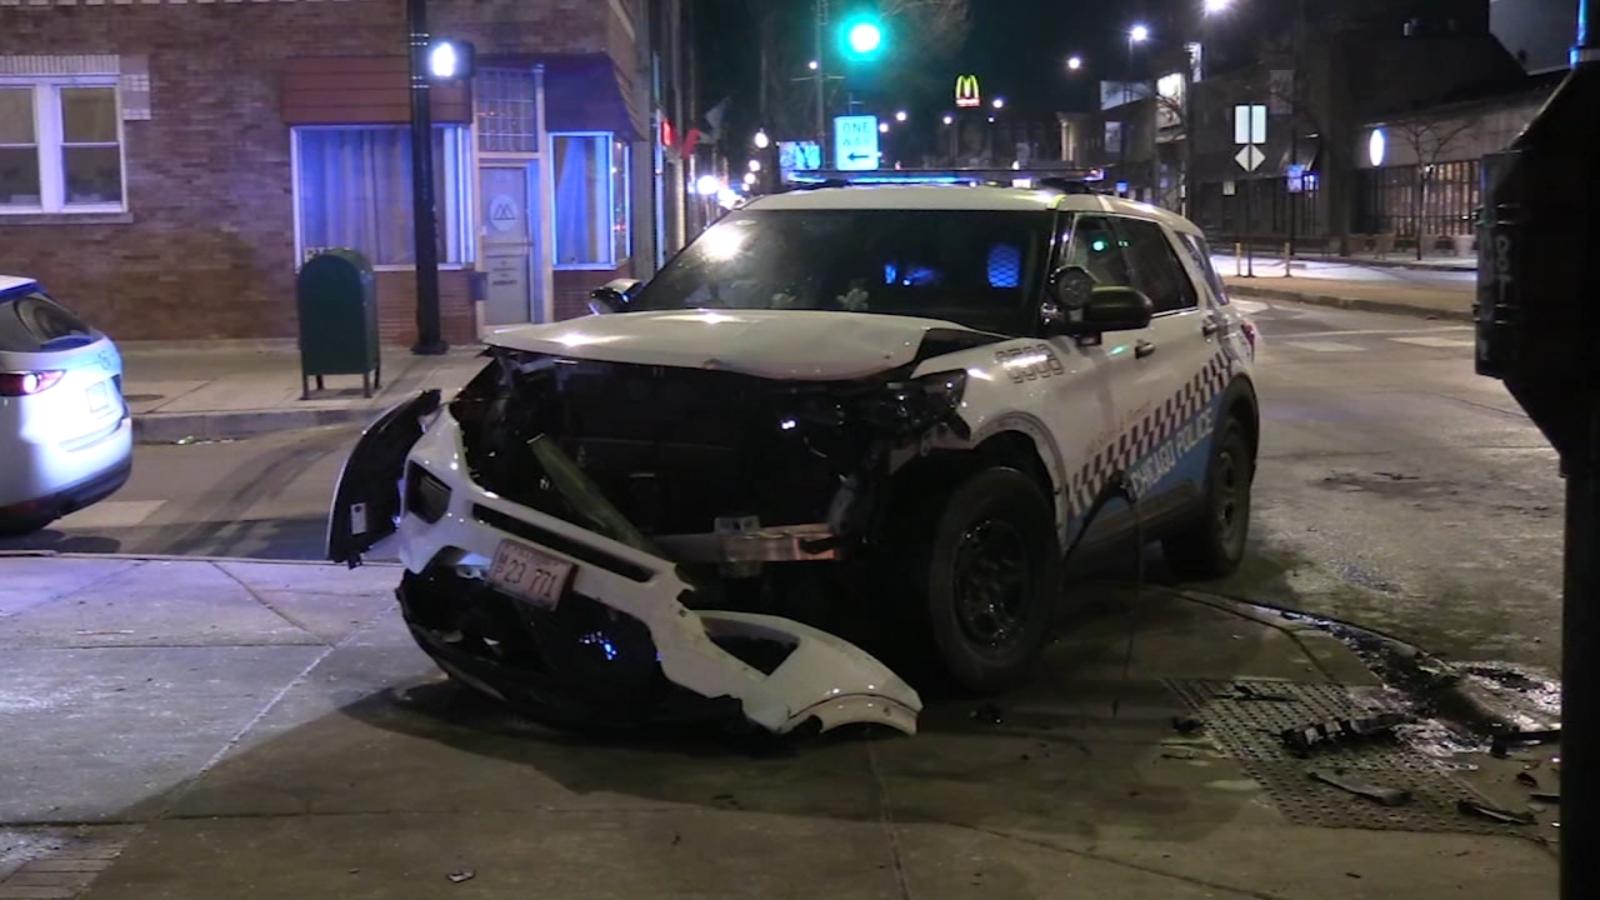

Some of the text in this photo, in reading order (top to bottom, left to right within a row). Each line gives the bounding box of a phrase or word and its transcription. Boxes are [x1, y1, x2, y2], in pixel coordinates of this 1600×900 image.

[843, 122, 868, 133] ONE
[1176, 406, 1214, 459] POLICE
[504, 559, 527, 585] 23
[530, 568, 557, 598] 771
